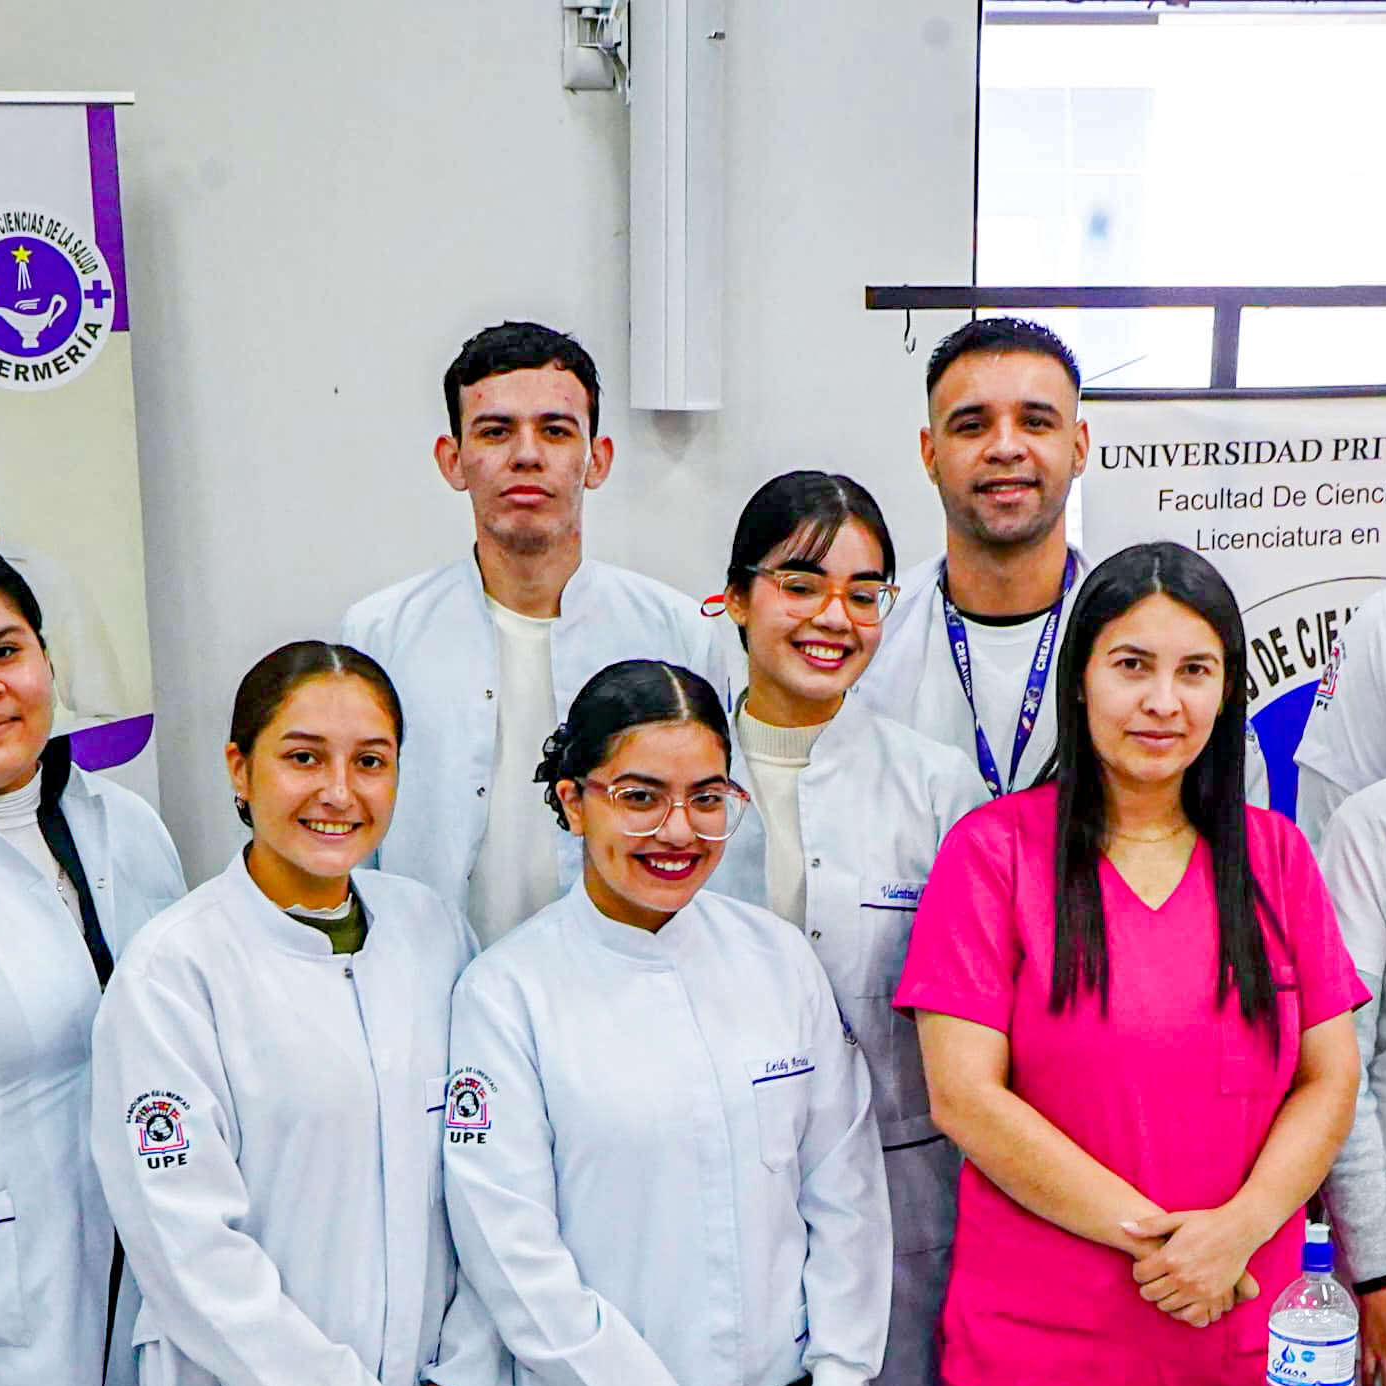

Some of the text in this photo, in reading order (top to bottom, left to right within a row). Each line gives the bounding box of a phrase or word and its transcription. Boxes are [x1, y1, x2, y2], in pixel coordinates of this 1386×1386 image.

[44, 218, 61, 241] DE
[57, 227, 75, 249] LA
[68, 239, 99, 276] SALUD
[1099, 438, 1324, 471] UNIVERSIDAD
[1158, 486, 1264, 513] Facultad
[1273, 484, 1307, 509] De
[1195, 527, 1342, 552] Licenciatura
[1351, 527, 1381, 545] en
[1250, 626, 1297, 688] DE
[450, 1131, 487, 1145] UPE
[147, 1152, 188, 1170] UPE
